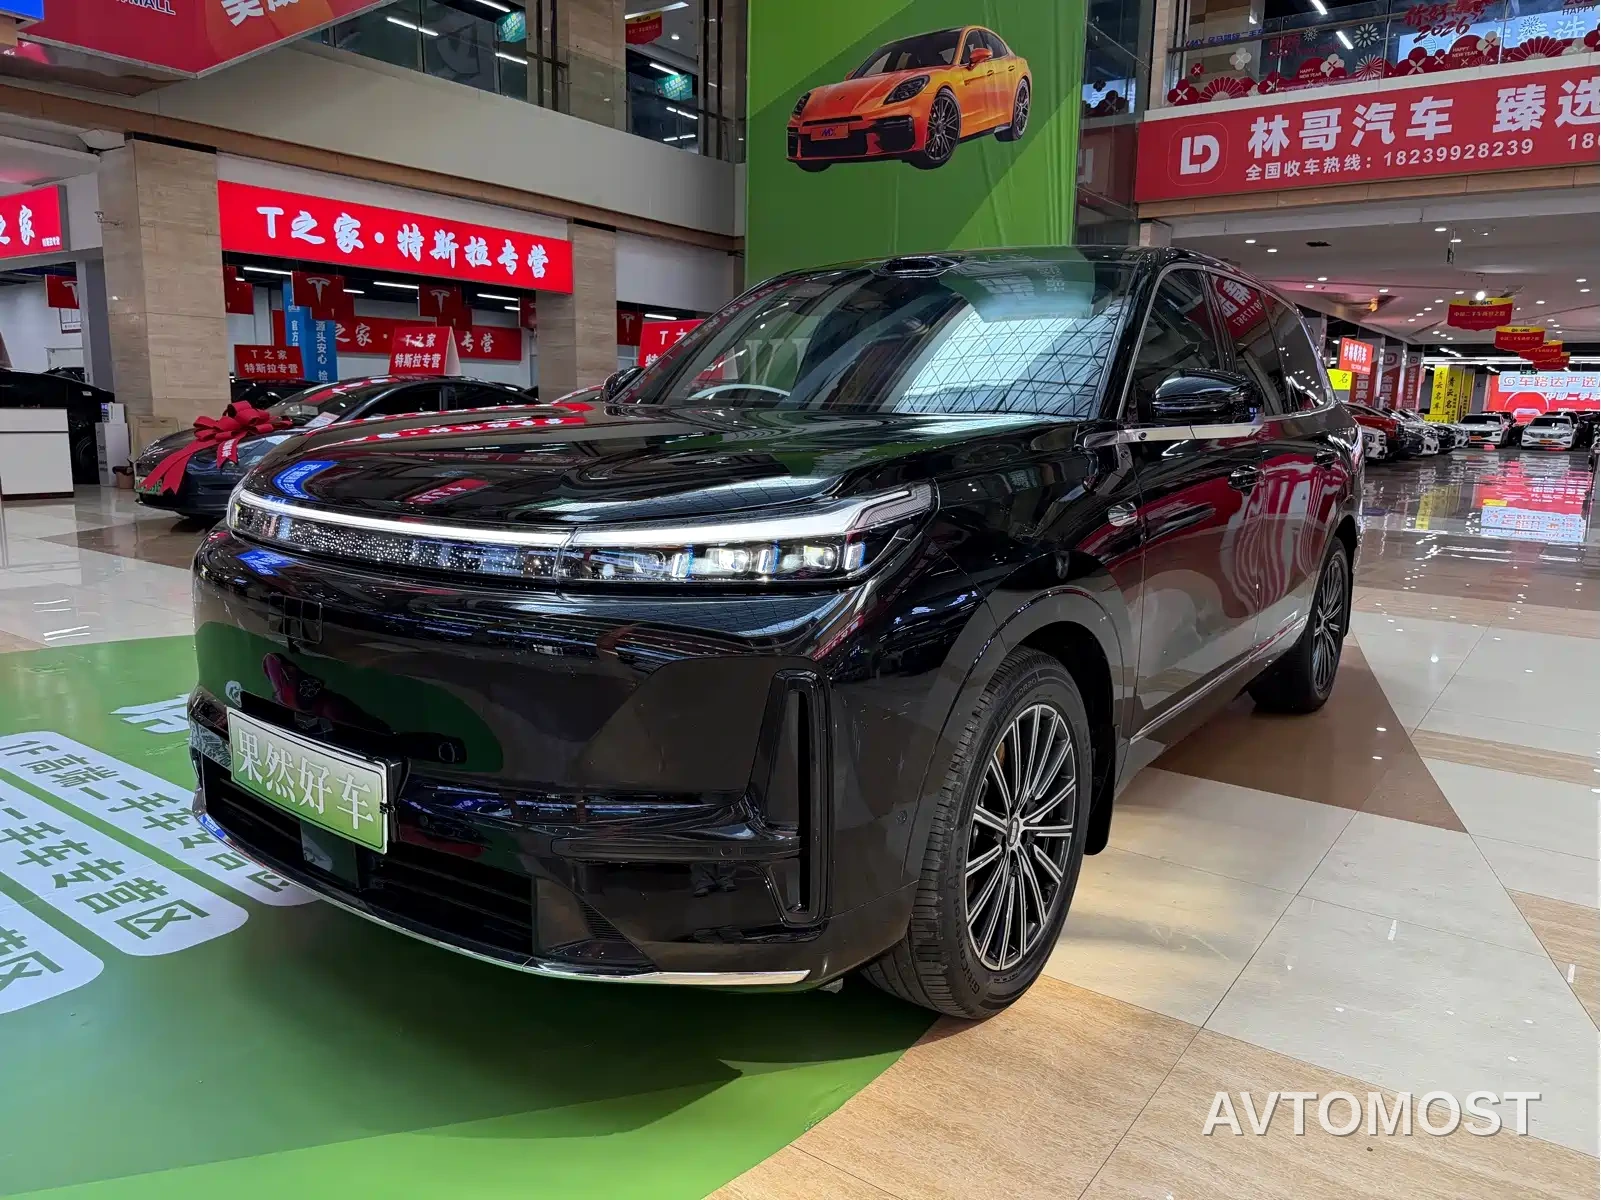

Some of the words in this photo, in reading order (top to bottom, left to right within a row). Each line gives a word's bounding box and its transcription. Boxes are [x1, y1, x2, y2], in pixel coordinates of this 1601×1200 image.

[1562, 5, 1596, 16] HAPPY
[1413, 16, 1470, 43] 2026
[1248, 96, 1454, 159] 林哥汽车
[1567, 132, 1600, 150] 18
[244, 363, 299, 375] 特斯拉专营
[394, 353, 442, 369] 特斯拉专营
[1519, 376, 1600, 388] 车路达严选
[236, 726, 374, 830] 果然好车
